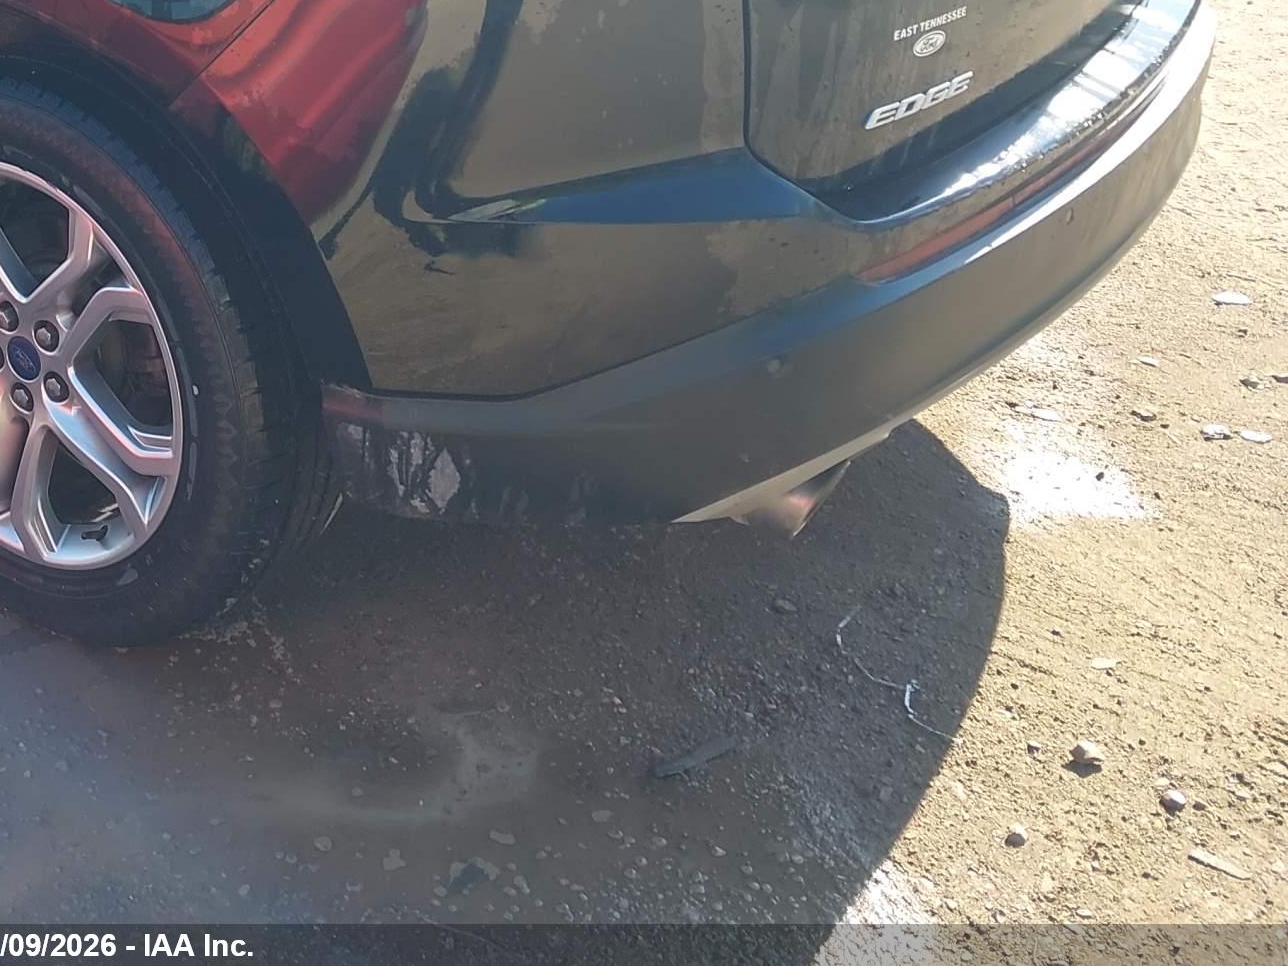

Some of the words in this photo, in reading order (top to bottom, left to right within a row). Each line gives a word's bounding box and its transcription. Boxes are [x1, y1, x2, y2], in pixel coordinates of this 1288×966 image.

[893, 23, 919, 42] EAST
[919, 6, 968, 32] TENNESSEE
[865, 70, 974, 130] EDGE
